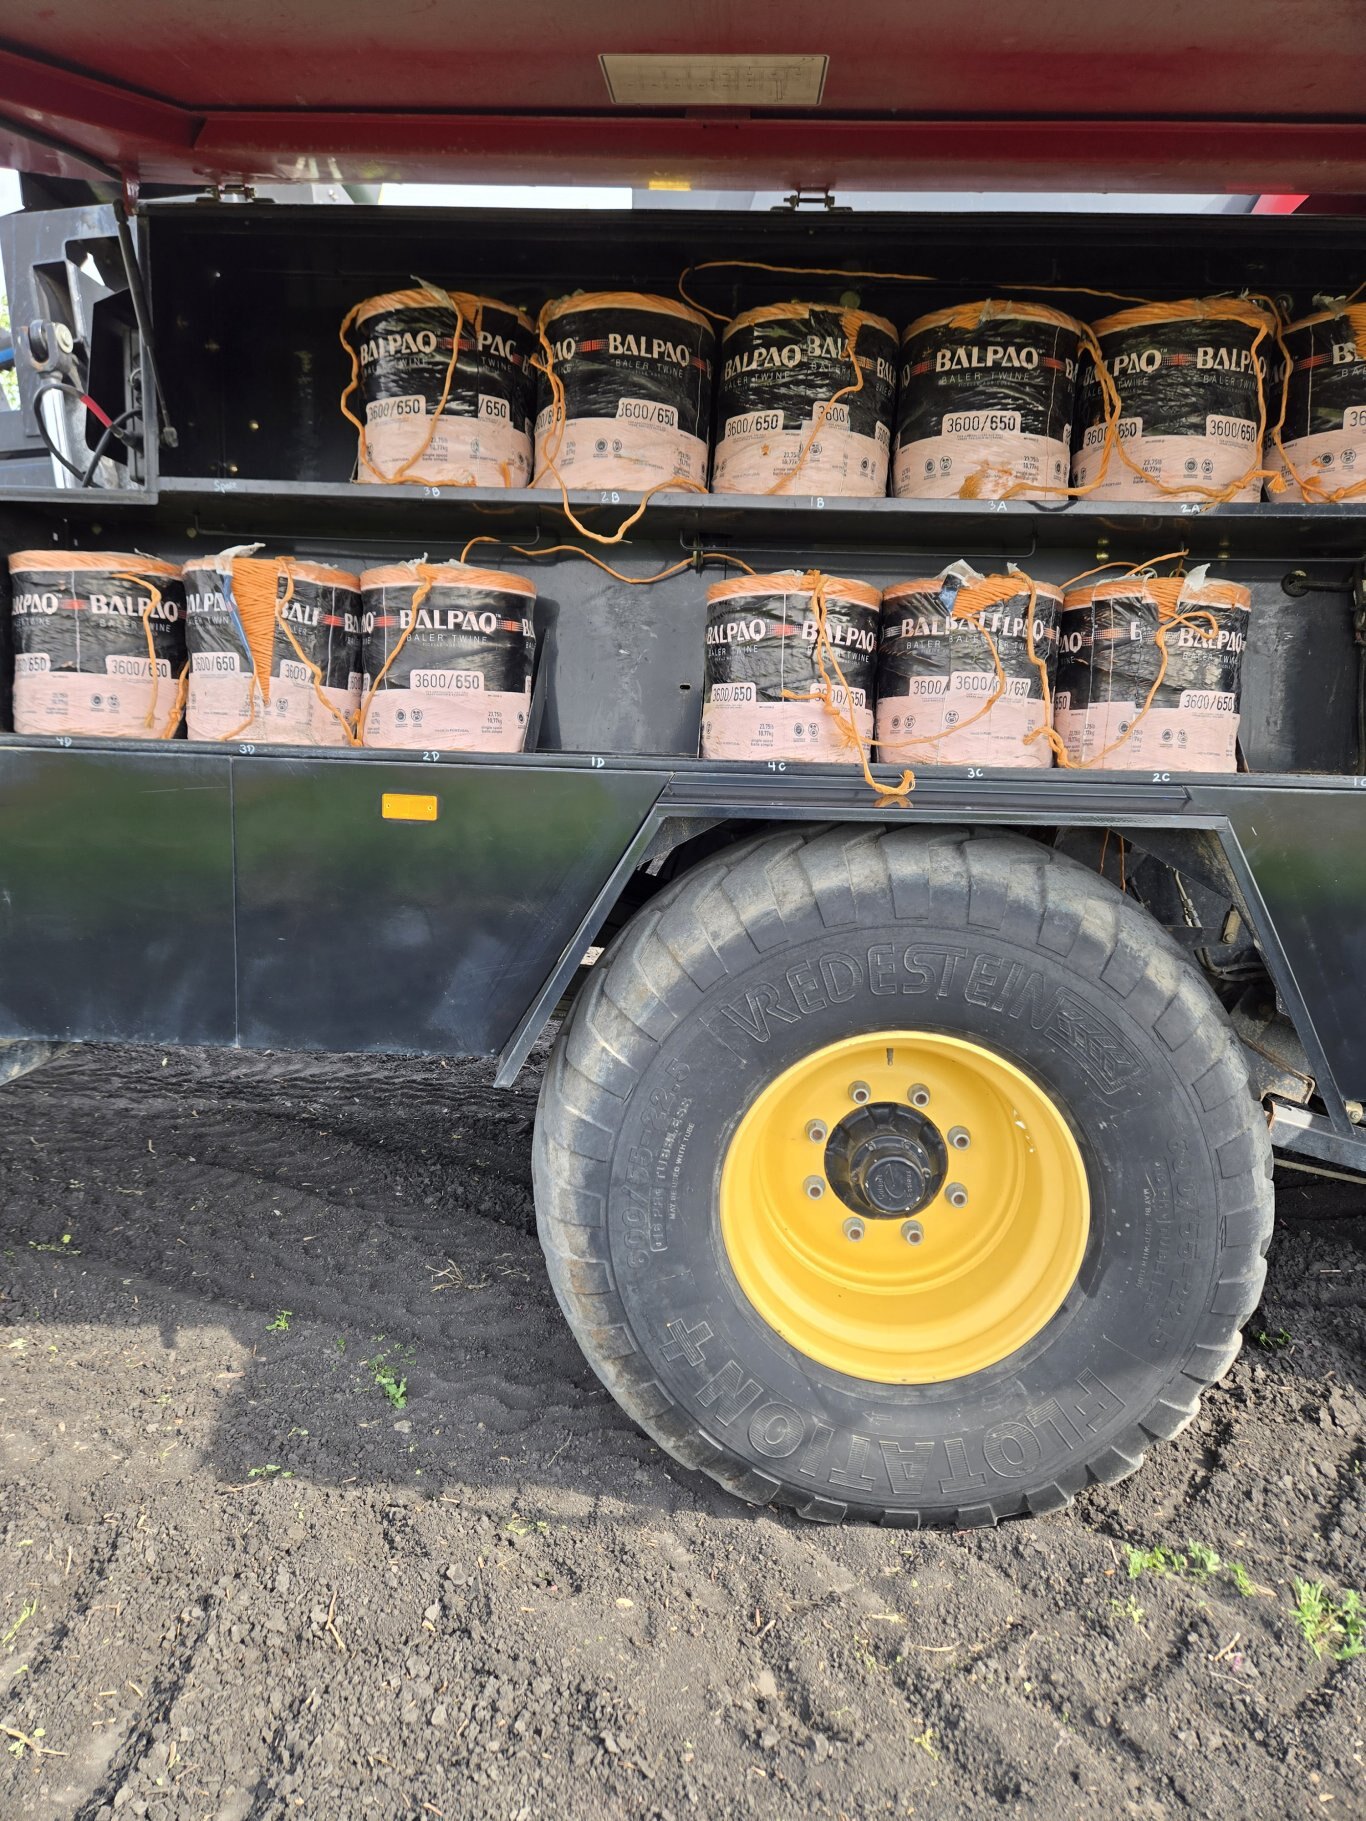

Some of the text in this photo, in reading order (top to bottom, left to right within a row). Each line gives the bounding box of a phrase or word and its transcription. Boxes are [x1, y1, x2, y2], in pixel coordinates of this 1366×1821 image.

[360, 330, 437, 366] BALPAQ
[608, 333, 690, 367] BALPAQ
[935, 346, 1039, 372] BALPAQ
[615, 358, 649, 370] BALER
[656, 363, 684, 379] TWINE
[724, 344, 802, 381] BALPAQ
[941, 371, 1030, 385] BALER TWINE
[368, 399, 421, 422] 3600/650
[618, 402, 675, 426] 3600/650
[727, 414, 779, 437] 3600/650
[946, 414, 1016, 433] 3600/650
[1209, 420, 1256, 443] 3600/650
[90, 593, 179, 623] BALPAQ
[399, 609, 498, 634] BALPAQ
[706, 618, 767, 645] BALPAQ
[407, 633, 488, 645] BALER TWINE
[414, 673, 480, 690] 3600/650
[712, 686, 752, 702] 3600/650
[1184, 694, 1233, 712] 3600/650
[423, 751, 440, 762] 2D
[592, 757, 605, 768] 1D
[967, 768, 984, 779] 3C
[1152, 773, 1171, 782] 2C
[721, 942, 1072, 1042] VREDESTEIN
[682, 1122, 695, 1143] TUBE
